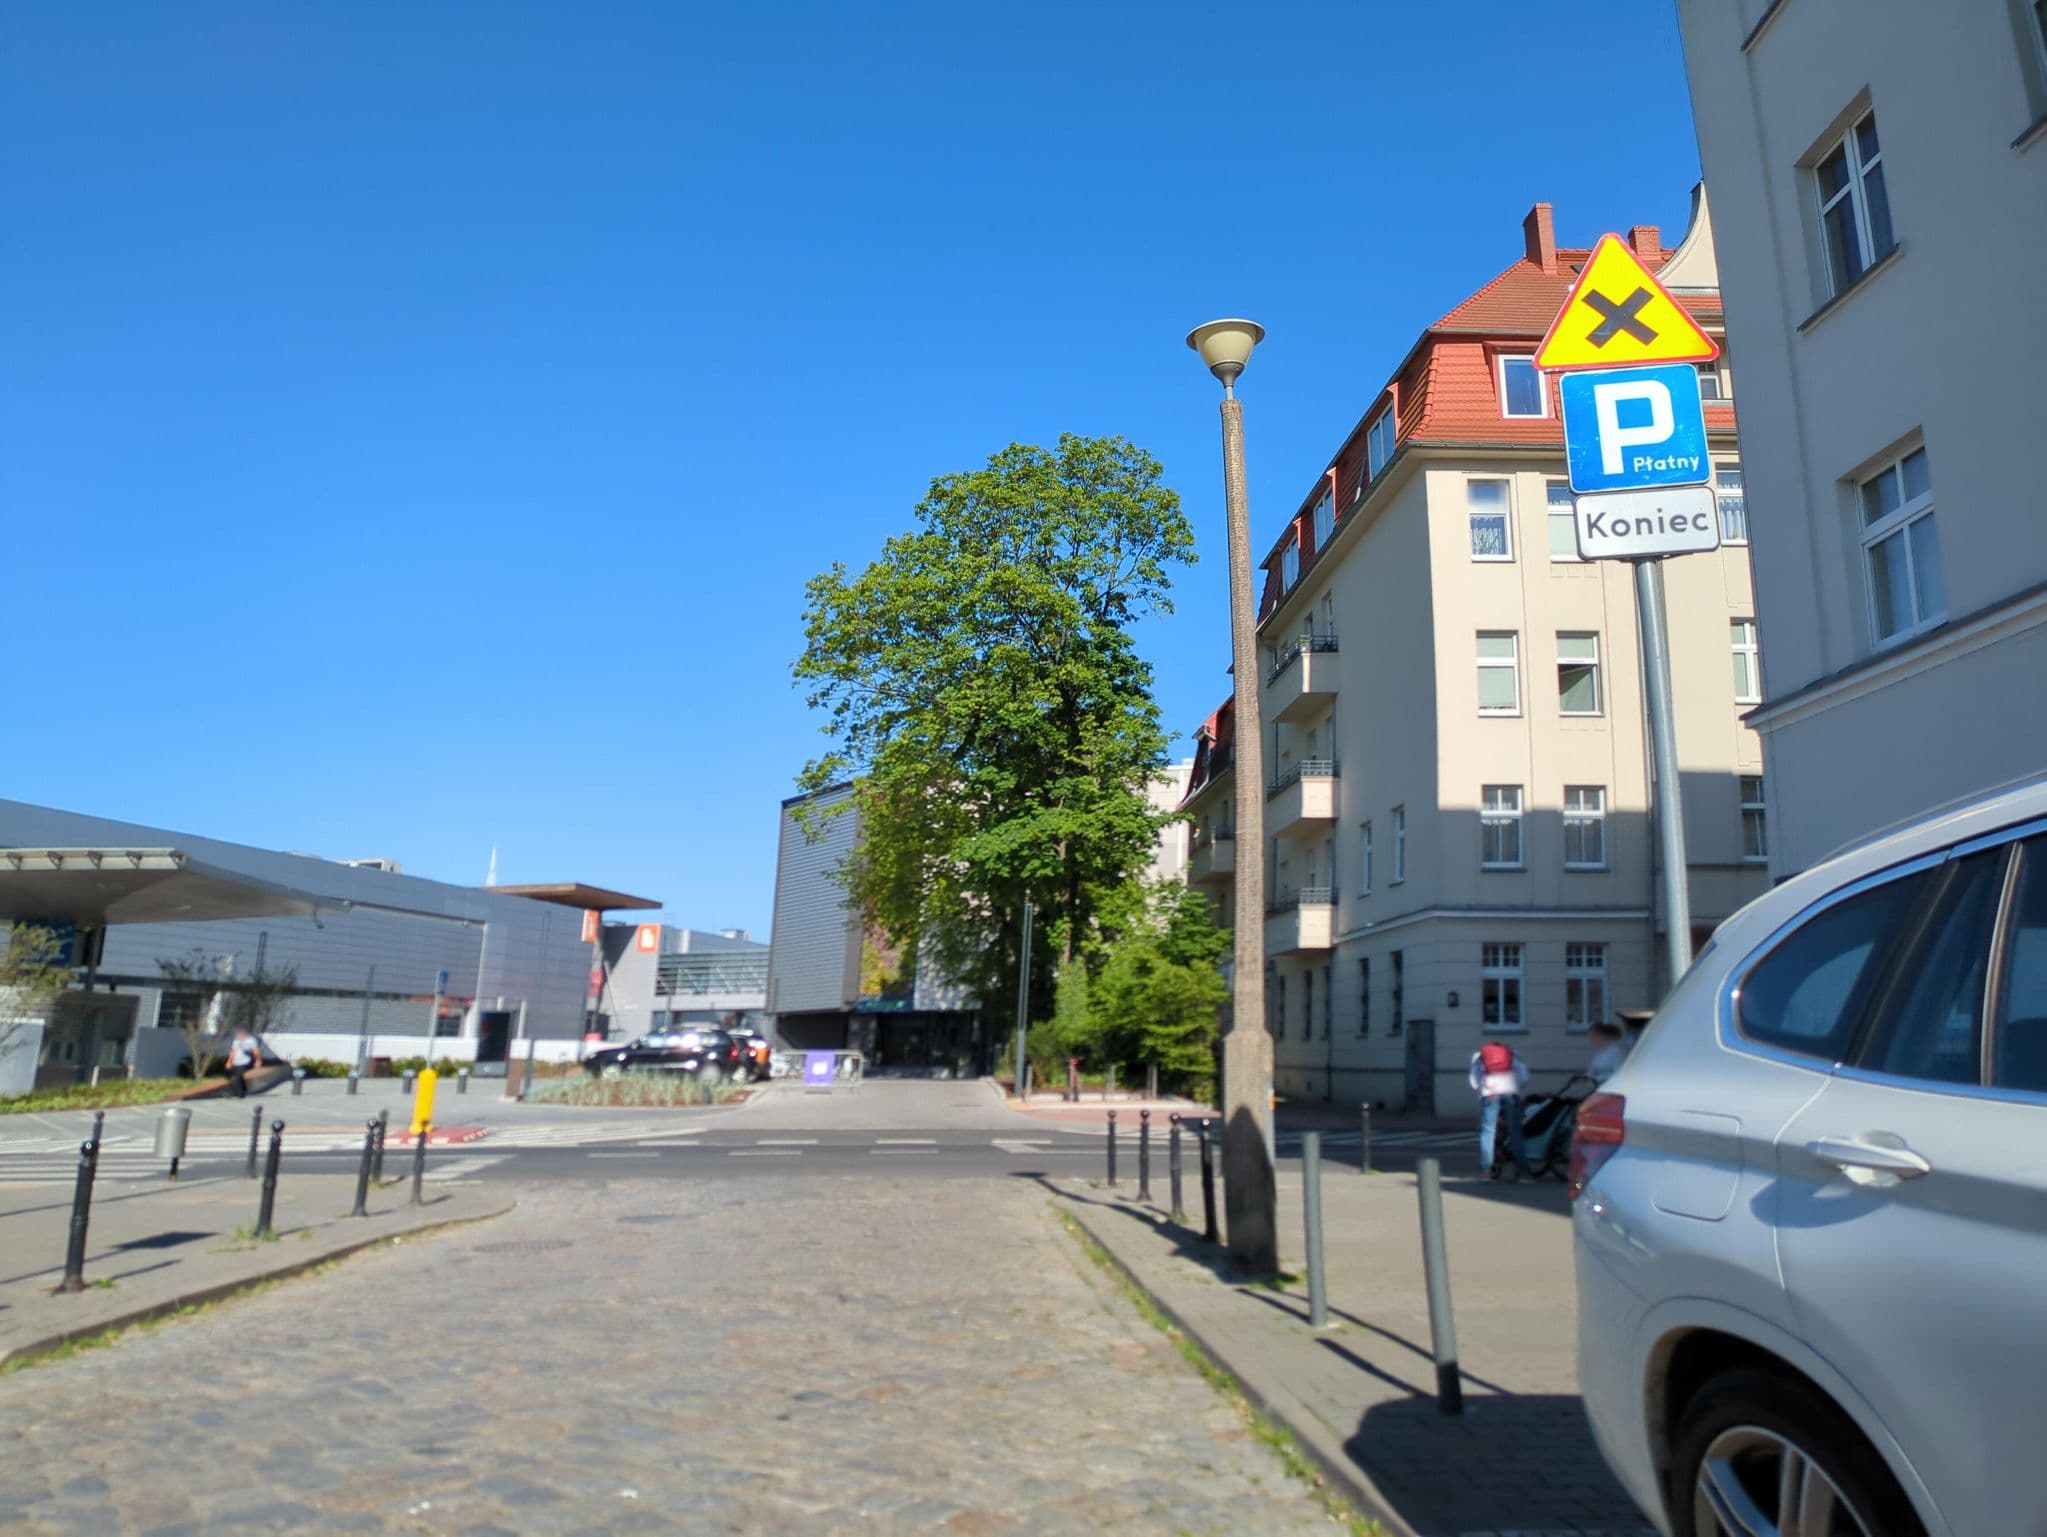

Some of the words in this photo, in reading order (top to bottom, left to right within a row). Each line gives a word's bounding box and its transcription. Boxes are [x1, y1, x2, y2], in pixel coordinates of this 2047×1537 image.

[1594, 380, 1674, 475] P
[1633, 455, 1700, 473] Płatny
[1586, 508, 1709, 539] Koniec
